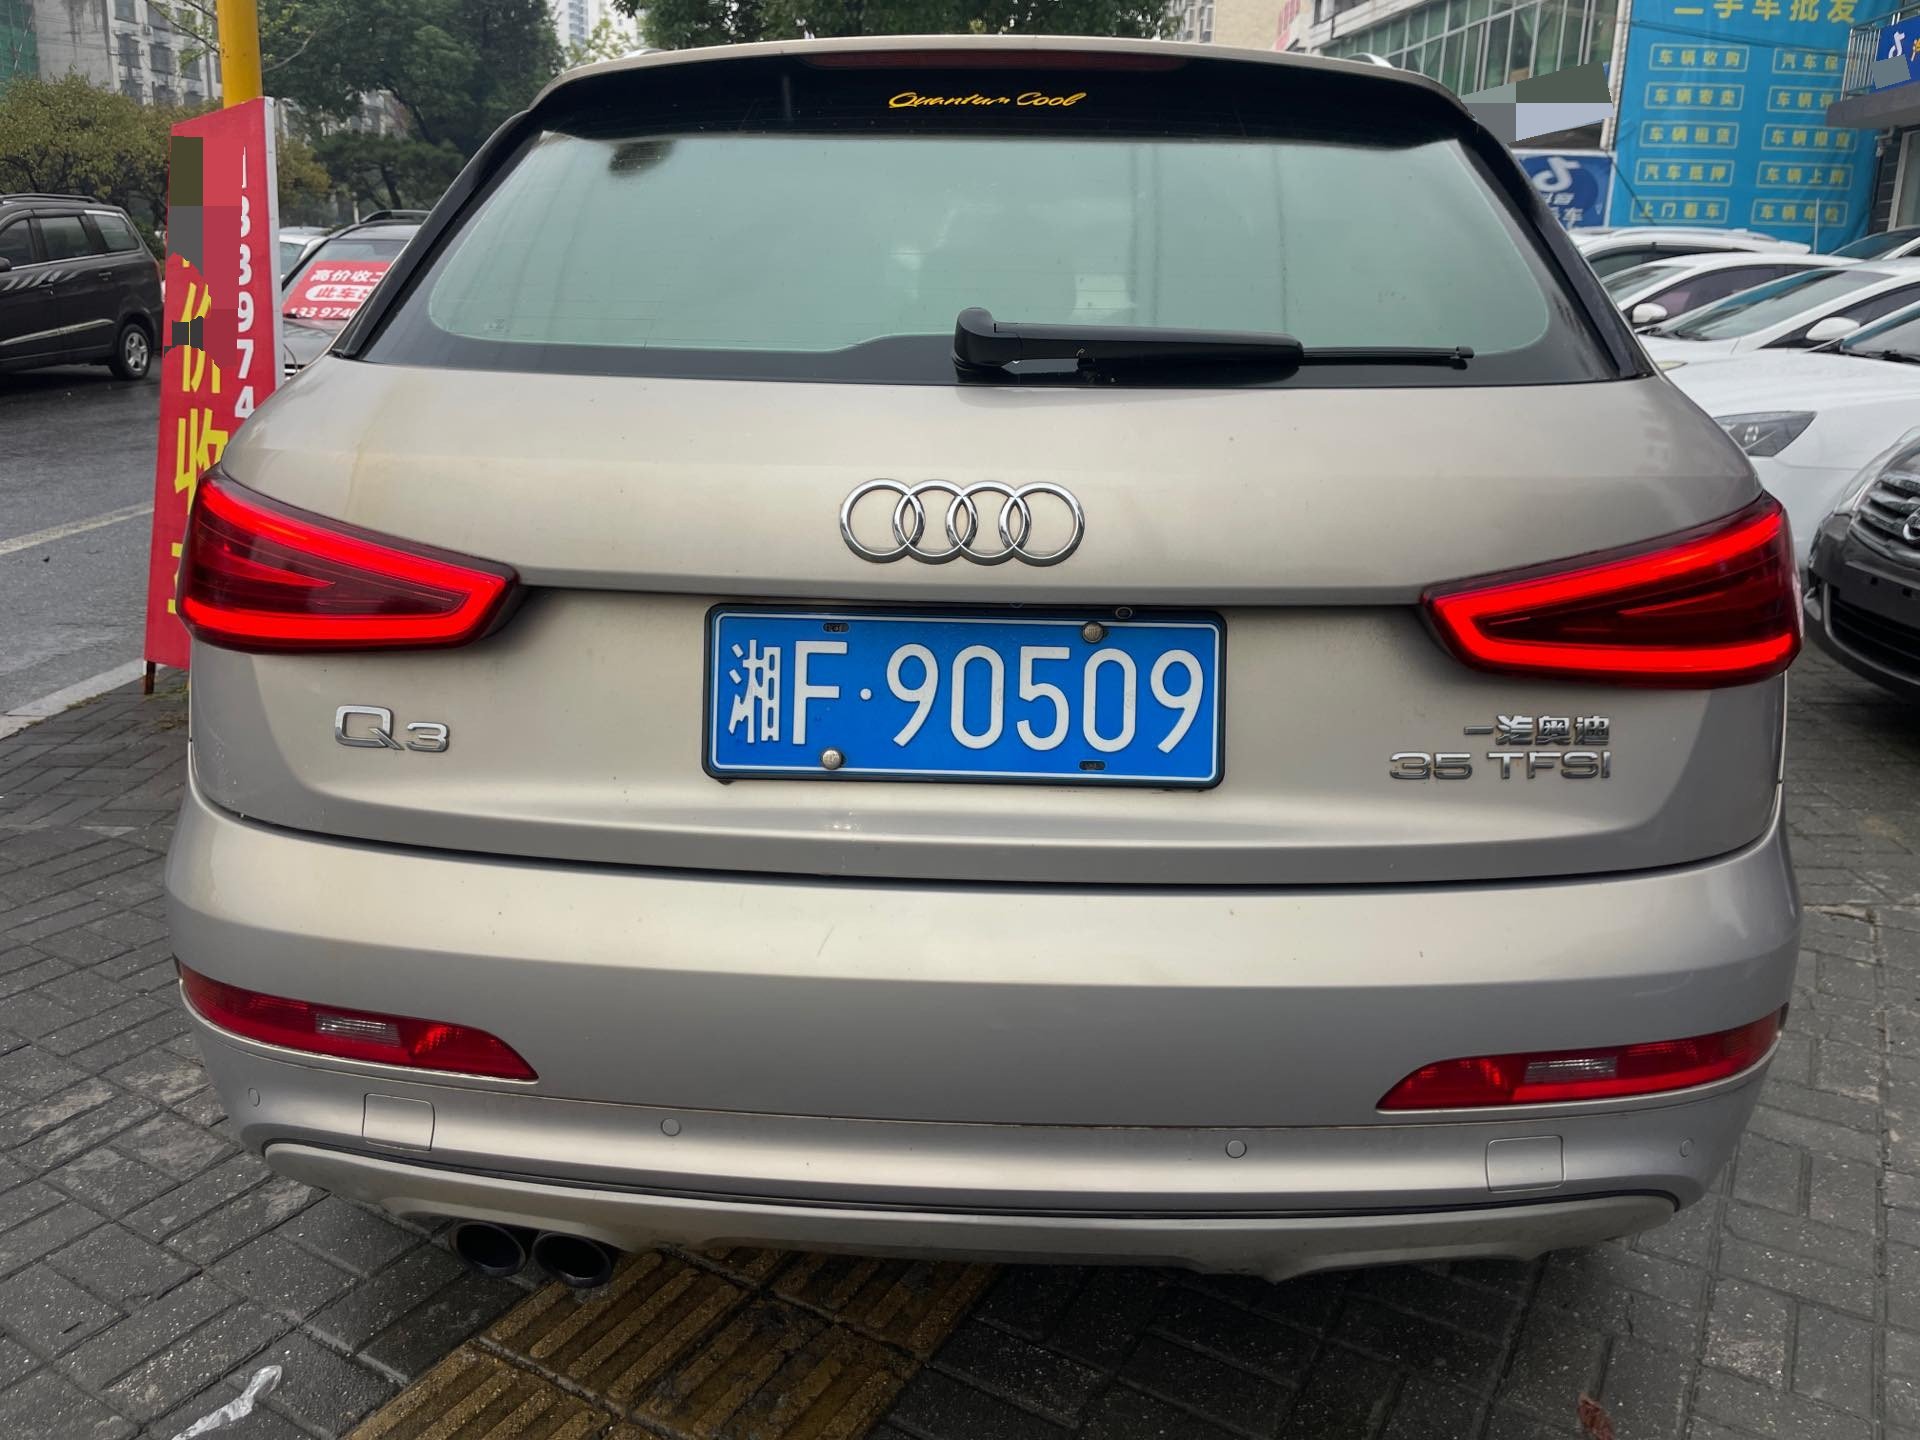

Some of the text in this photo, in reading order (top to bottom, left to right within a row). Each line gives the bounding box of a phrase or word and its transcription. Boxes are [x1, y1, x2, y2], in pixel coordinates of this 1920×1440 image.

[1781, 52, 1857, 70] 汽车保
[888, 91, 1087, 109] Quantum Cool
[335, 704, 450, 753] Q3
[1463, 714, 1610, 746] 一汽奥迪
[1389, 750, 1611, 780] 35 TFSI
